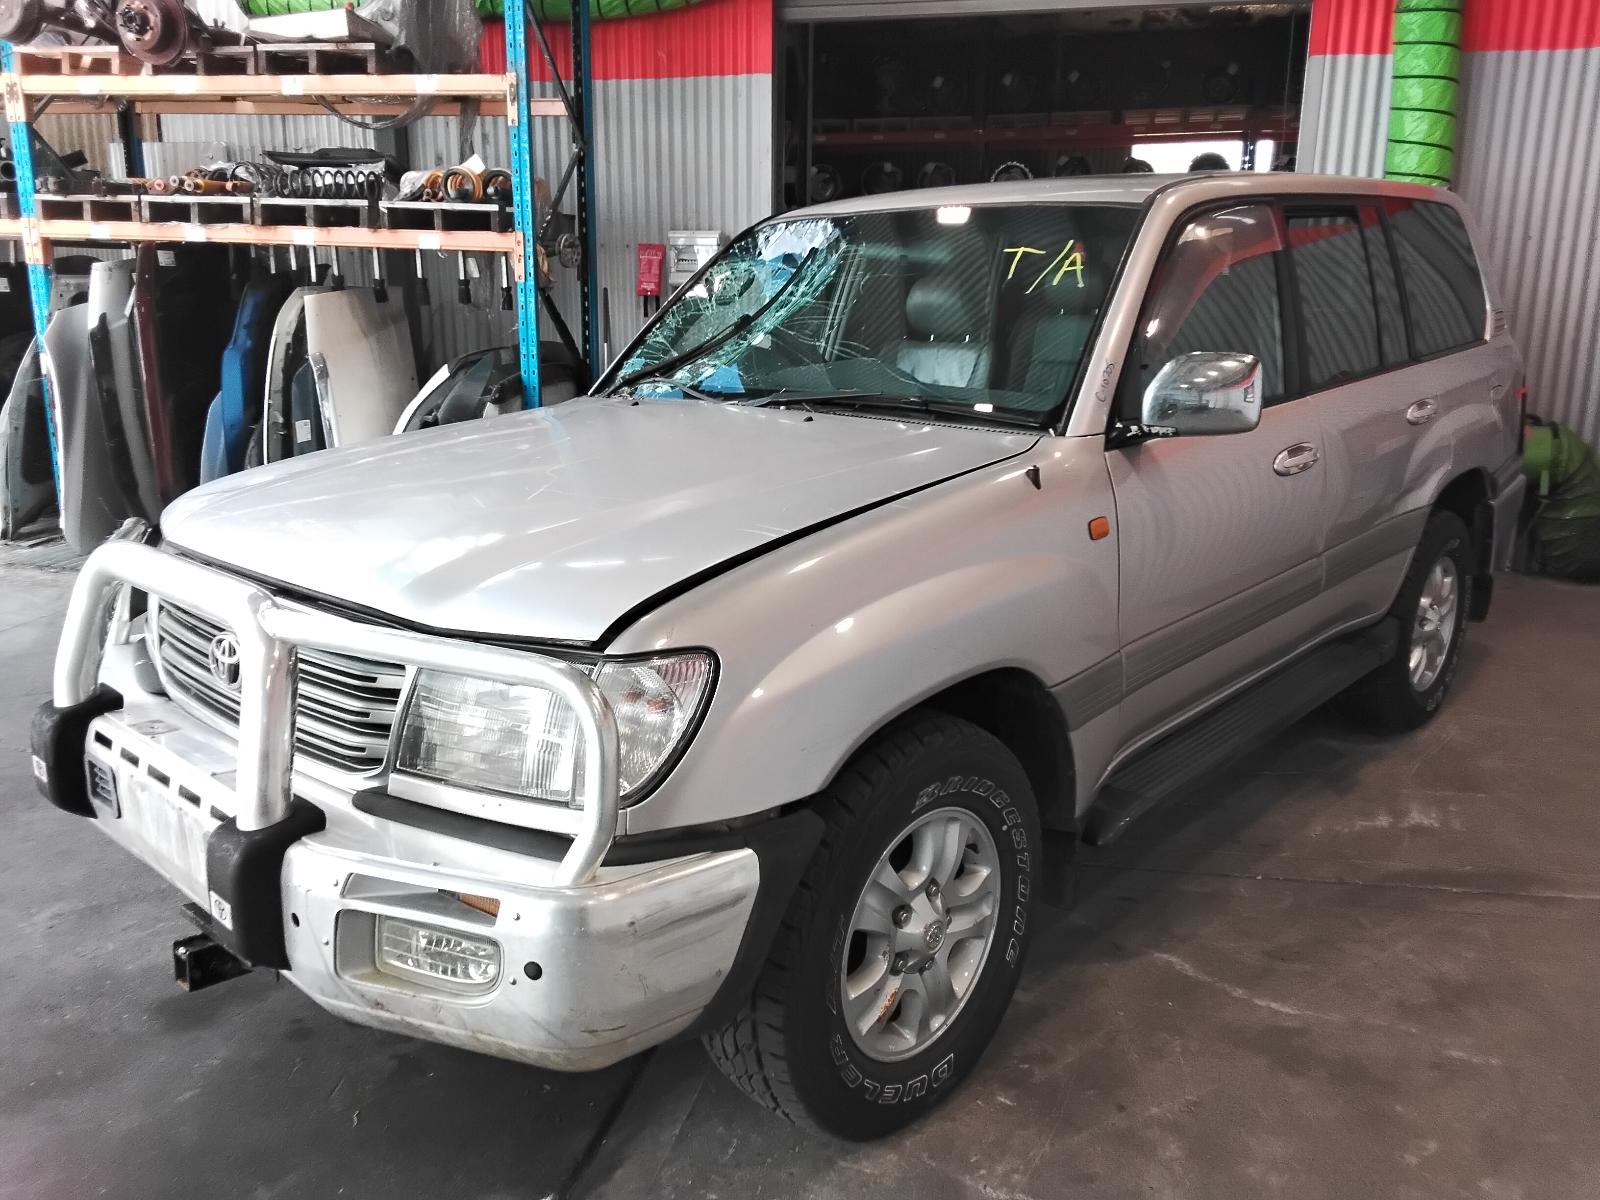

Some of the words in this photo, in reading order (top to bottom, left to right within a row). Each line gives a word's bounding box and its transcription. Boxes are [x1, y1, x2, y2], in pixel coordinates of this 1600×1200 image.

[1003, 239, 1085, 294] T/A
[911, 775, 1030, 968] BRIDGESTONE
[829, 1032, 955, 1105] DUELER
